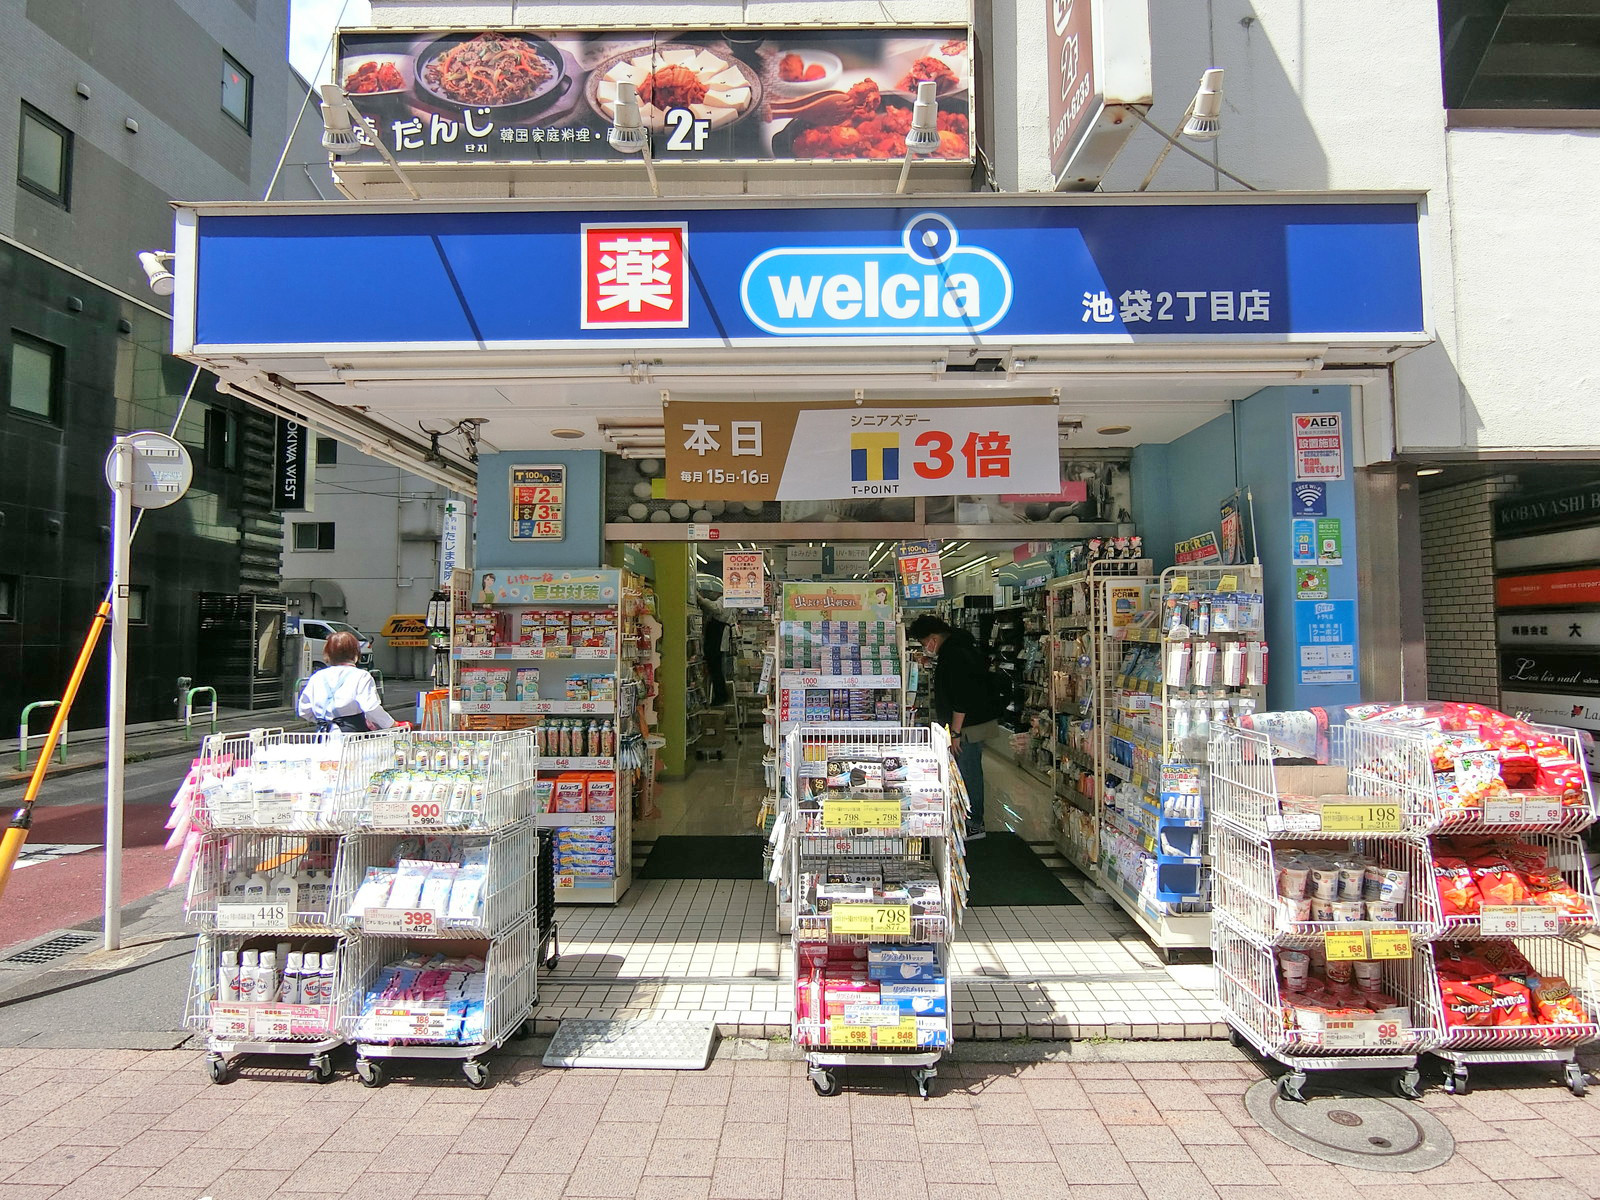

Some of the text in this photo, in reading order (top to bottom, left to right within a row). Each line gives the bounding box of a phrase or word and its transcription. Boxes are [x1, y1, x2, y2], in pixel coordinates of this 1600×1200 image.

[391, 106, 494, 151] だんじ
[666, 107, 711, 151] 2F
[465, 143, 488, 153] 단지
[596, 237, 674, 312] 薬
[768, 261, 980, 320] welcia
[1081, 289, 1270, 323] 池袋2丁目店
[850, 414, 931, 428] シニアズデー
[1310, 417, 1337, 427] AED
[681, 418, 763, 457] 本日
[912, 430, 1012, 480] 3倍
[285, 464, 297, 500] WEST
[1295, 484, 1323, 492] FREE Wi-Fi
[851, 484, 900, 495] T-POINT
[1501, 495, 1585, 523] KOBAYASHI
[825, 555, 830, 566] 1
[532, 584, 601, 600] 害虫対策
[390, 619, 424, 634] Times
[1568, 623, 1582, 637] 大
[1557, 671, 1582, 683] nail
[411, 804, 440, 817] 900
[1368, 808, 1396, 822] 198
[1547, 809, 1558, 817] 69
[421, 817, 435, 825] 990
[844, 814, 859, 822] 798
[882, 814, 898, 822] 798
[1375, 821, 1390, 829] 213
[258, 907, 284, 920] 448
[404, 912, 433, 925] 398
[876, 909, 906, 923] 798
[1505, 920, 1516, 928] 69
[1348, 945, 1363, 953] 168
[1451, 1003, 1491, 1013] Doritos
[231, 1022, 245, 1030] 298
[273, 1023, 288, 1031] 298
[413, 1027, 429, 1035] 350
[1377, 1024, 1397, 1038] 98
[850, 1031, 866, 1039] 698
[897, 1031, 913, 1039] 848
